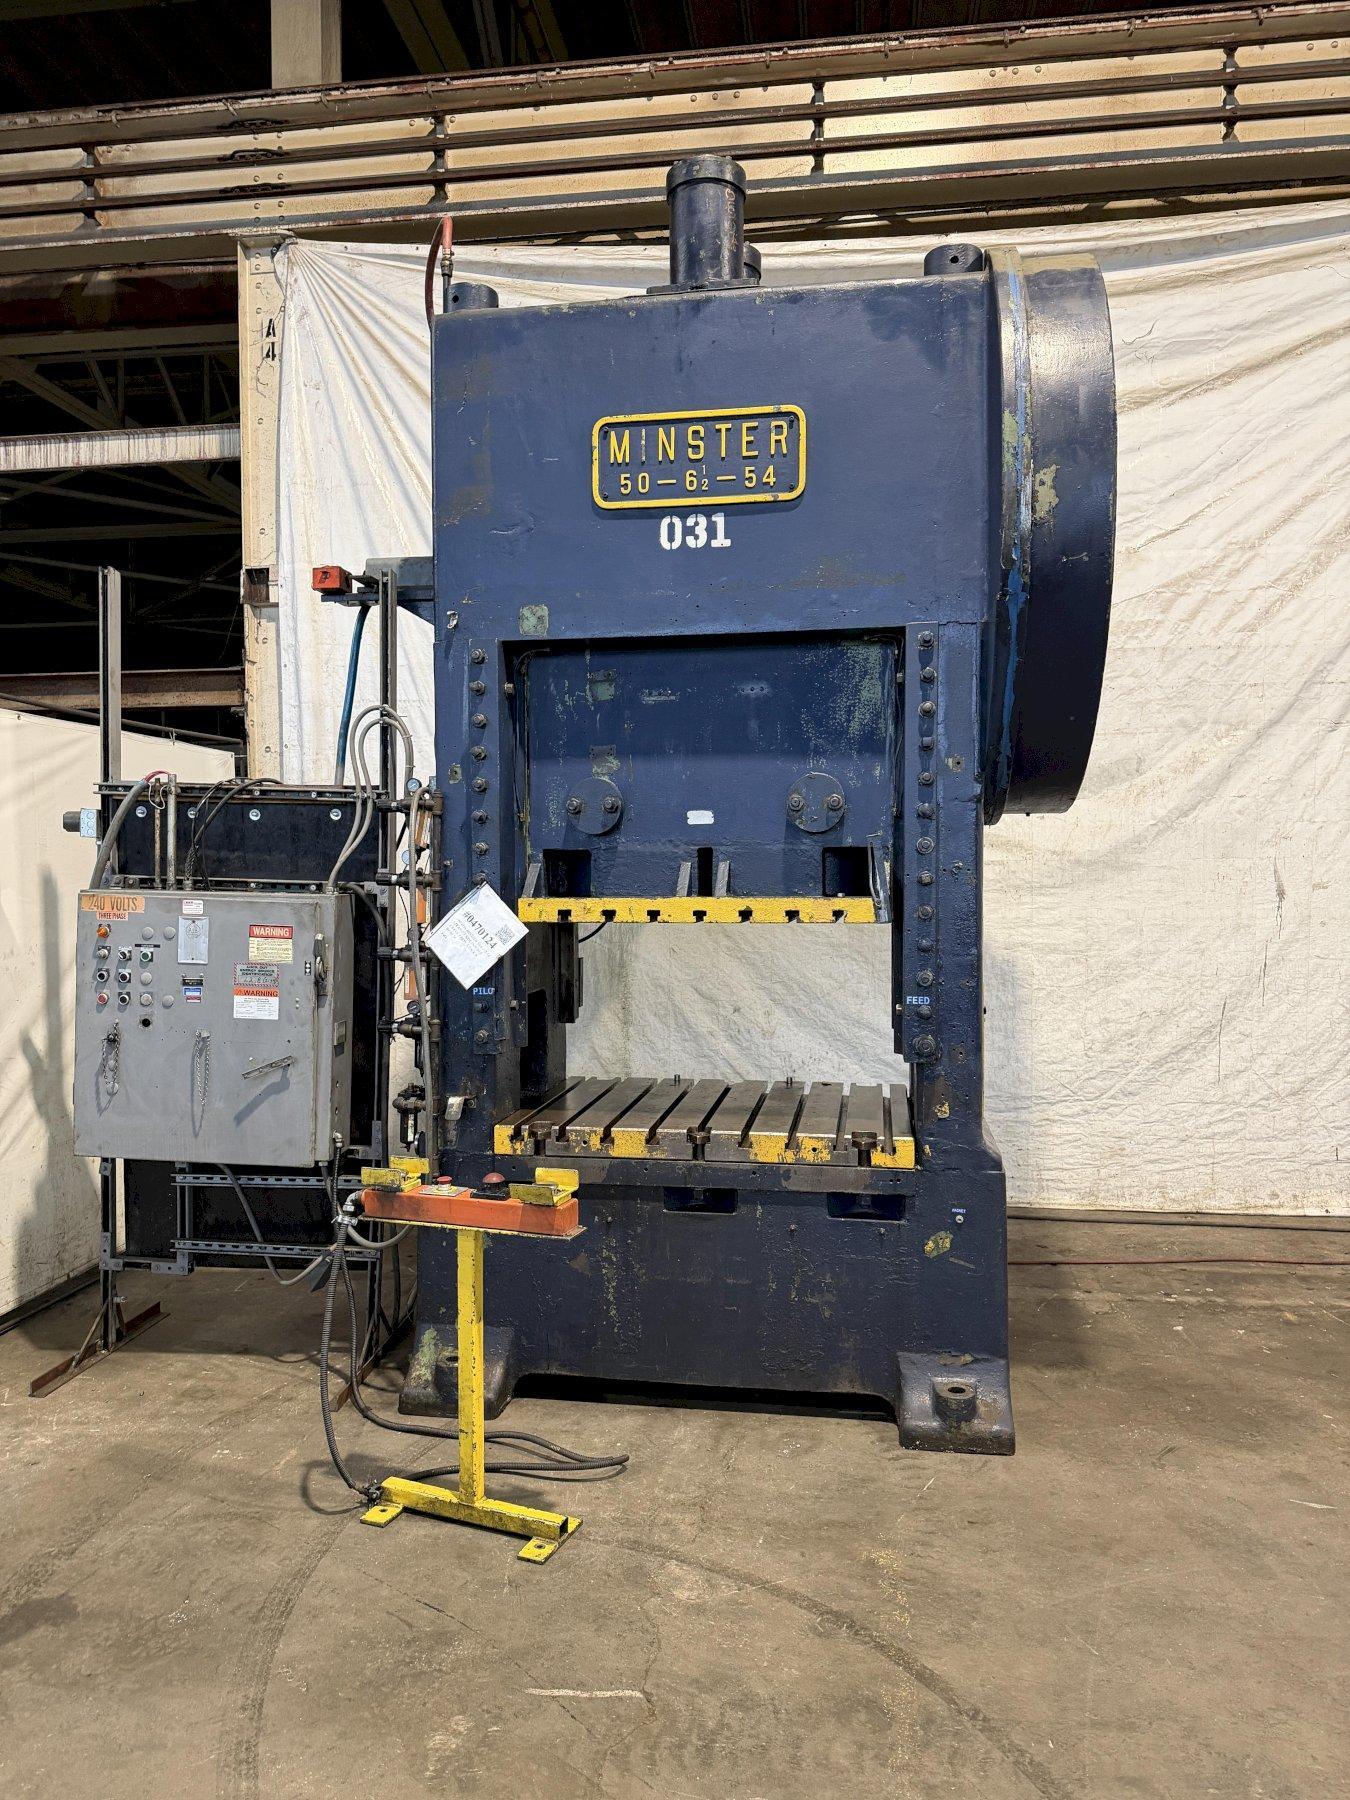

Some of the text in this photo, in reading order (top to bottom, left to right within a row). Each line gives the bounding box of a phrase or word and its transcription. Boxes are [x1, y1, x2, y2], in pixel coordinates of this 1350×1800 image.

[265, 318, 277, 338] A
[265, 341, 277, 361] 4
[609, 419, 789, 465] MINSTER
[659, 512, 732, 550] 031
[88, 895, 138, 911] 240 VOLTS
[98, 912, 127, 920] THREE PHASE
[252, 926, 290, 937] WARNING
[461, 909, 499, 950] #0470124
[243, 989, 279, 998] WARNING
[906, 996, 931, 1005] FEED
